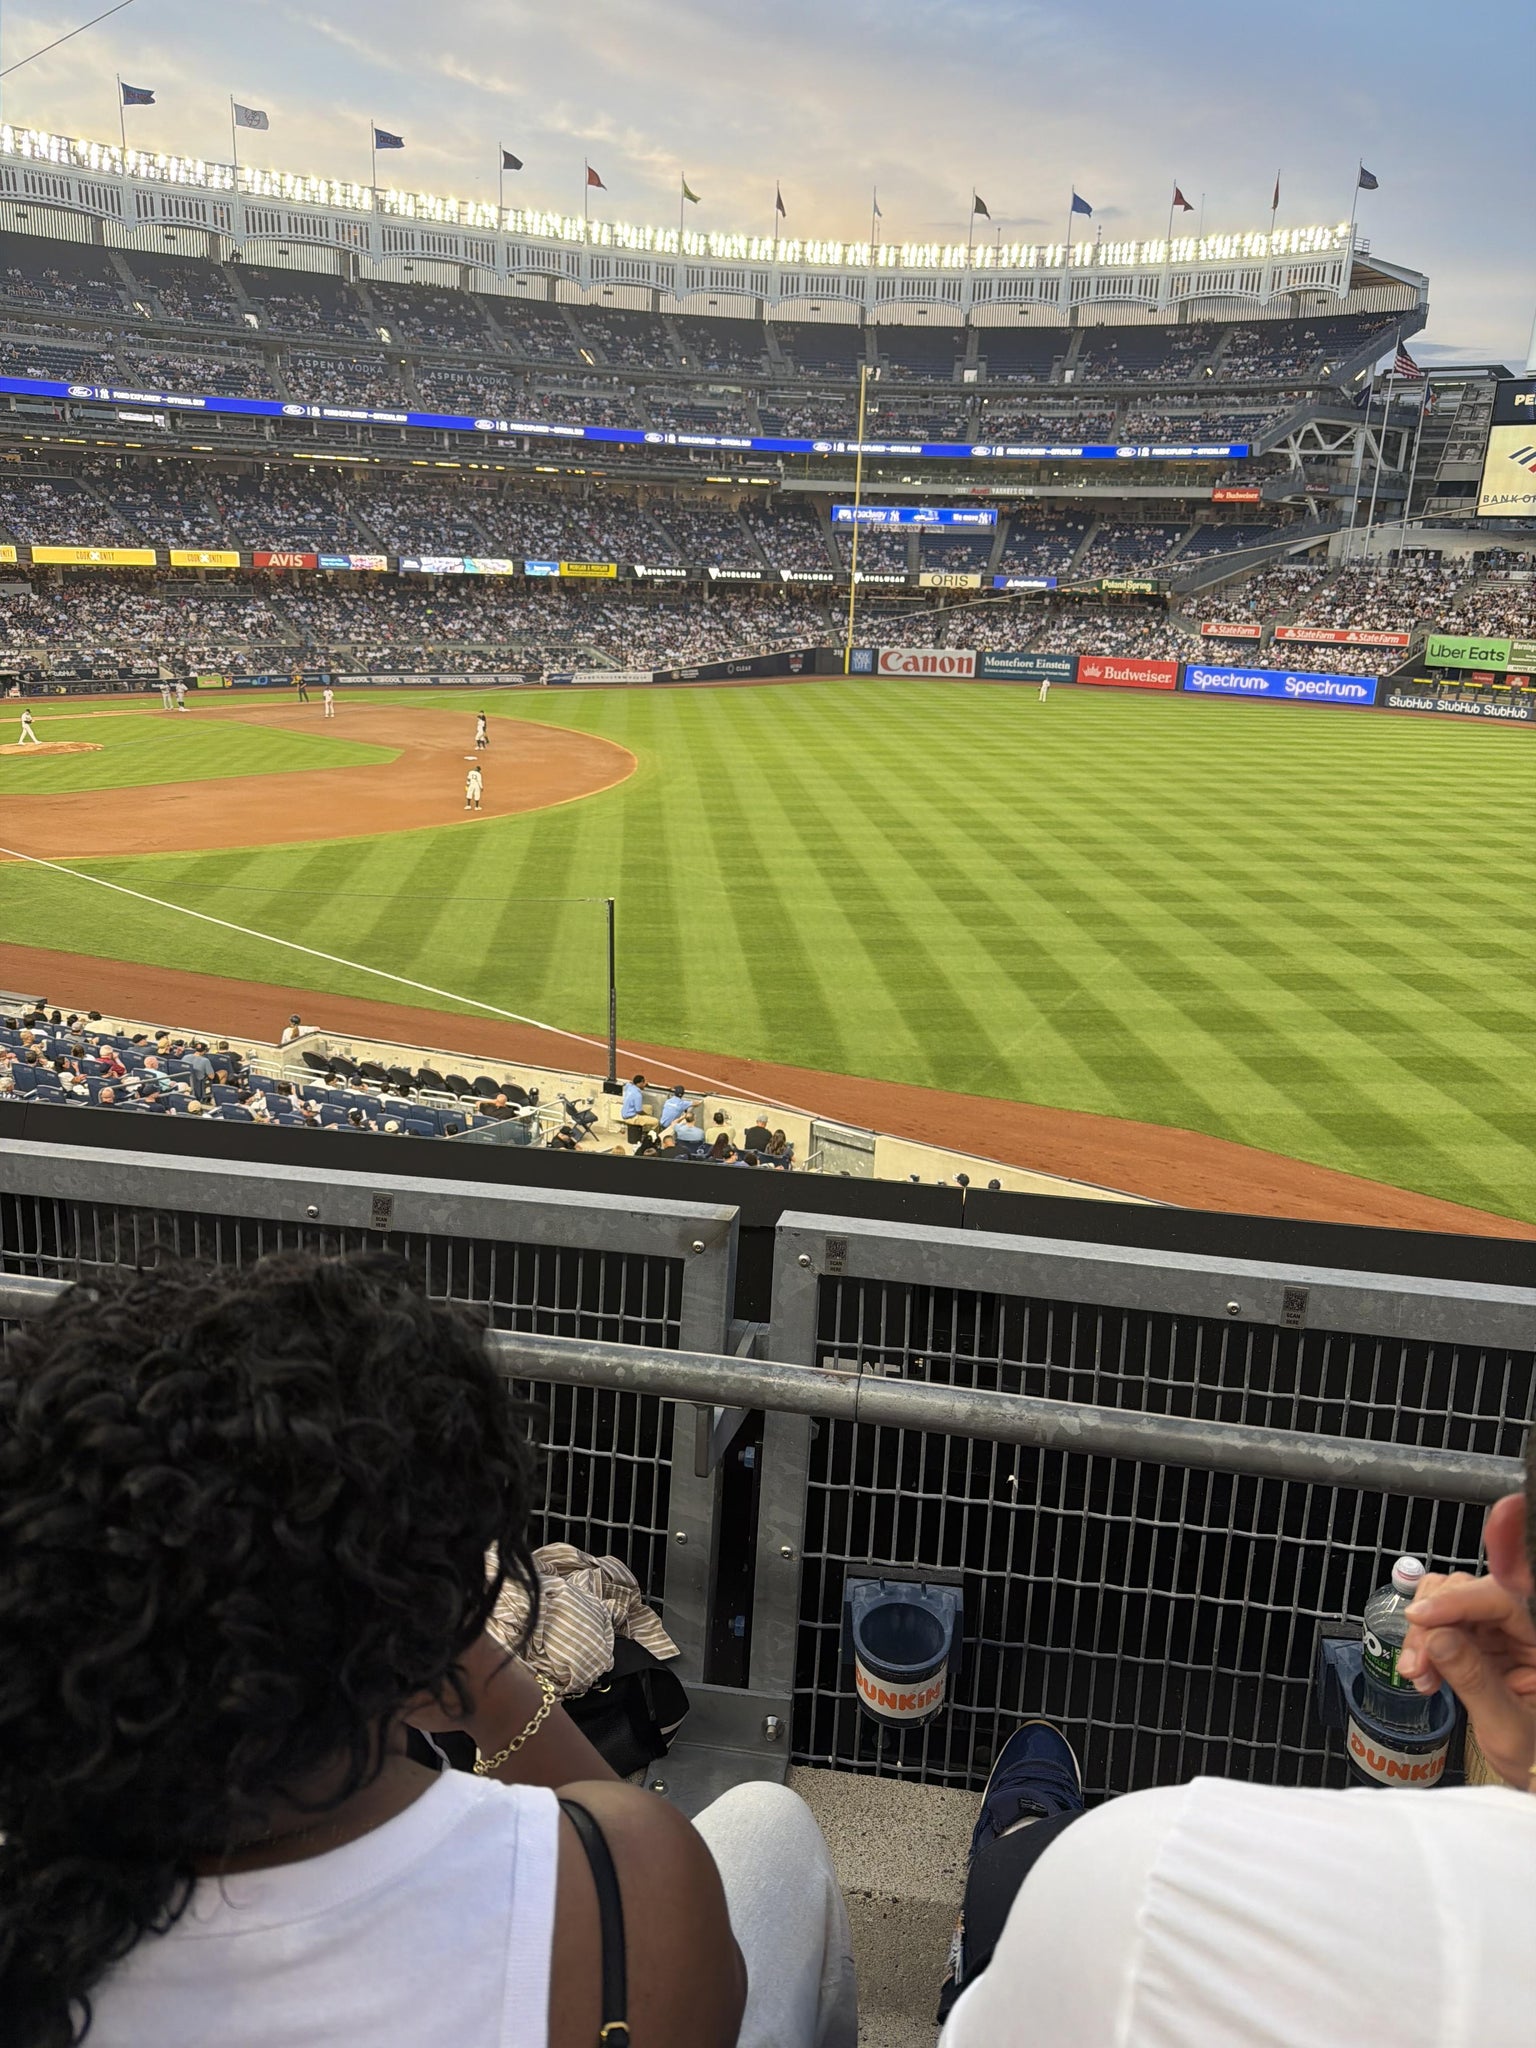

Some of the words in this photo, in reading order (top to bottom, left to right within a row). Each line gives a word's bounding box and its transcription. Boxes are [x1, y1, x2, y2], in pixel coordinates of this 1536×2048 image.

[298, 359, 334, 370] ASPEN
[348, 364, 384, 374] VODKA
[430, 372, 464, 382] ASPEN
[476, 376, 508, 386] VODKA
[1514, 394, 1536, 406] PE
[1483, 495, 1517, 503] BANK
[268, 554, 303, 566] AVIS
[931, 575, 968, 587] ORIS
[1102, 580, 1125, 590] Poland
[1126, 581, 1152, 592] Spring
[1430, 644, 1466, 658] Uber
[1469, 647, 1505, 662] Eats
[880, 651, 973, 674] Canon
[985, 656, 1034, 668] Montefiore
[1036, 658, 1070, 670] Einstein
[1104, 666, 1170, 683] Budweiser
[1193, 671, 1264, 690] Spectrum
[1285, 677, 1361, 697] Spectrum
[1389, 696, 1433, 710] StubHub
[1437, 700, 1480, 714] StubHub
[1484, 705, 1527, 718] StubHub
